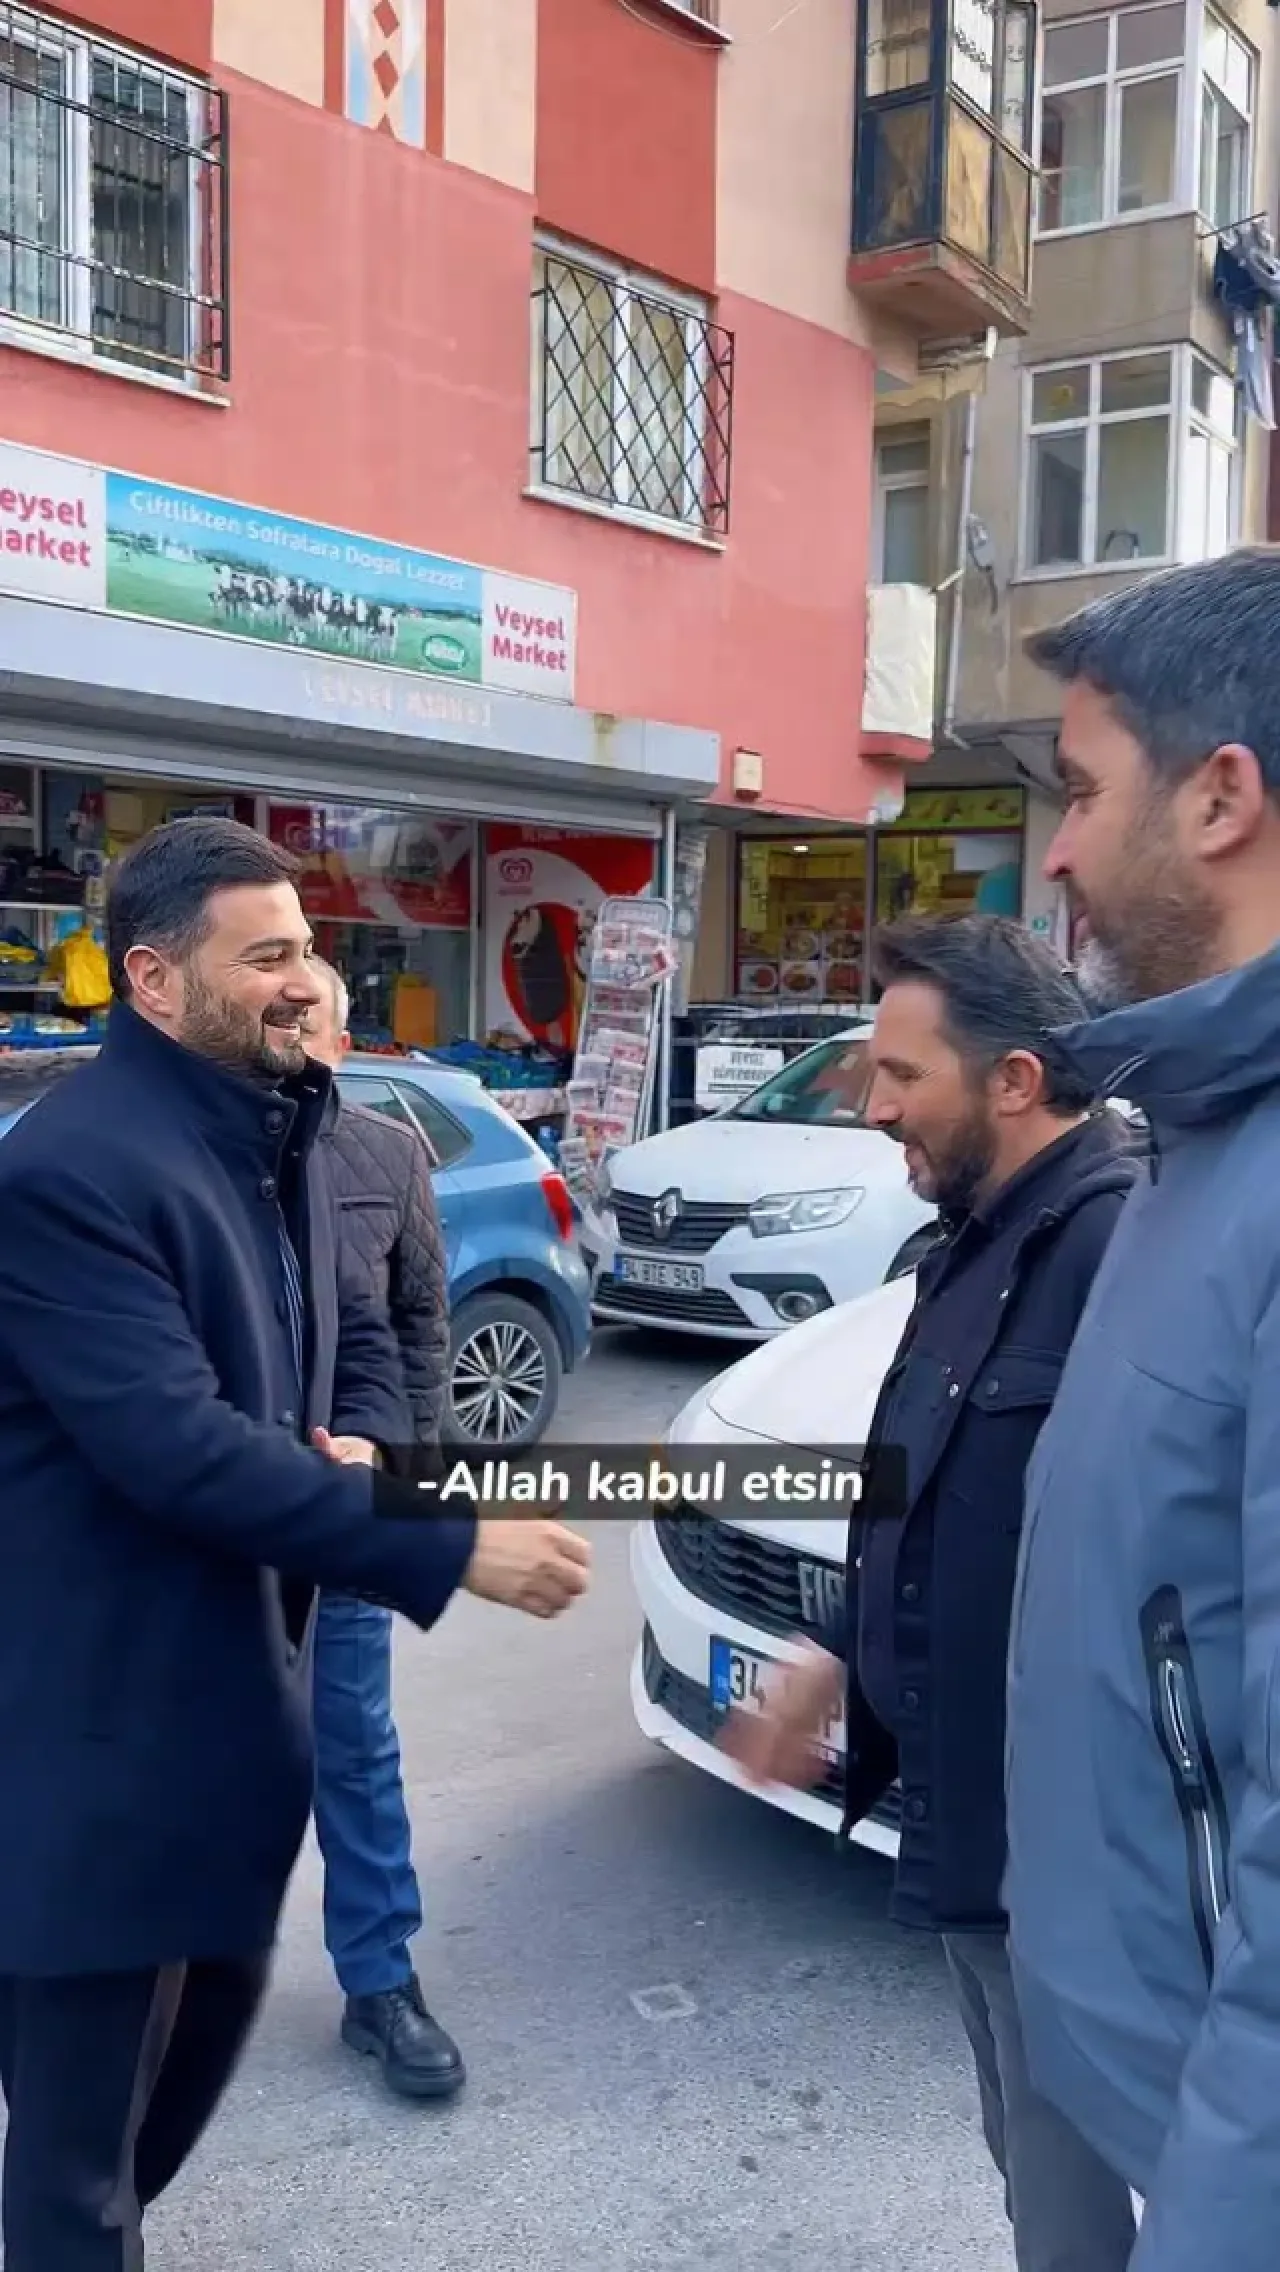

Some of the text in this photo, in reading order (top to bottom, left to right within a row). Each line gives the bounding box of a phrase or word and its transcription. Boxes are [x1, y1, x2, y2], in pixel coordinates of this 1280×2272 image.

[0, 527, 91, 568] arket
[495, 602, 565, 641] Veysel
[493, 633, 567, 672] Market
[798, 1560, 847, 1627] FIA
